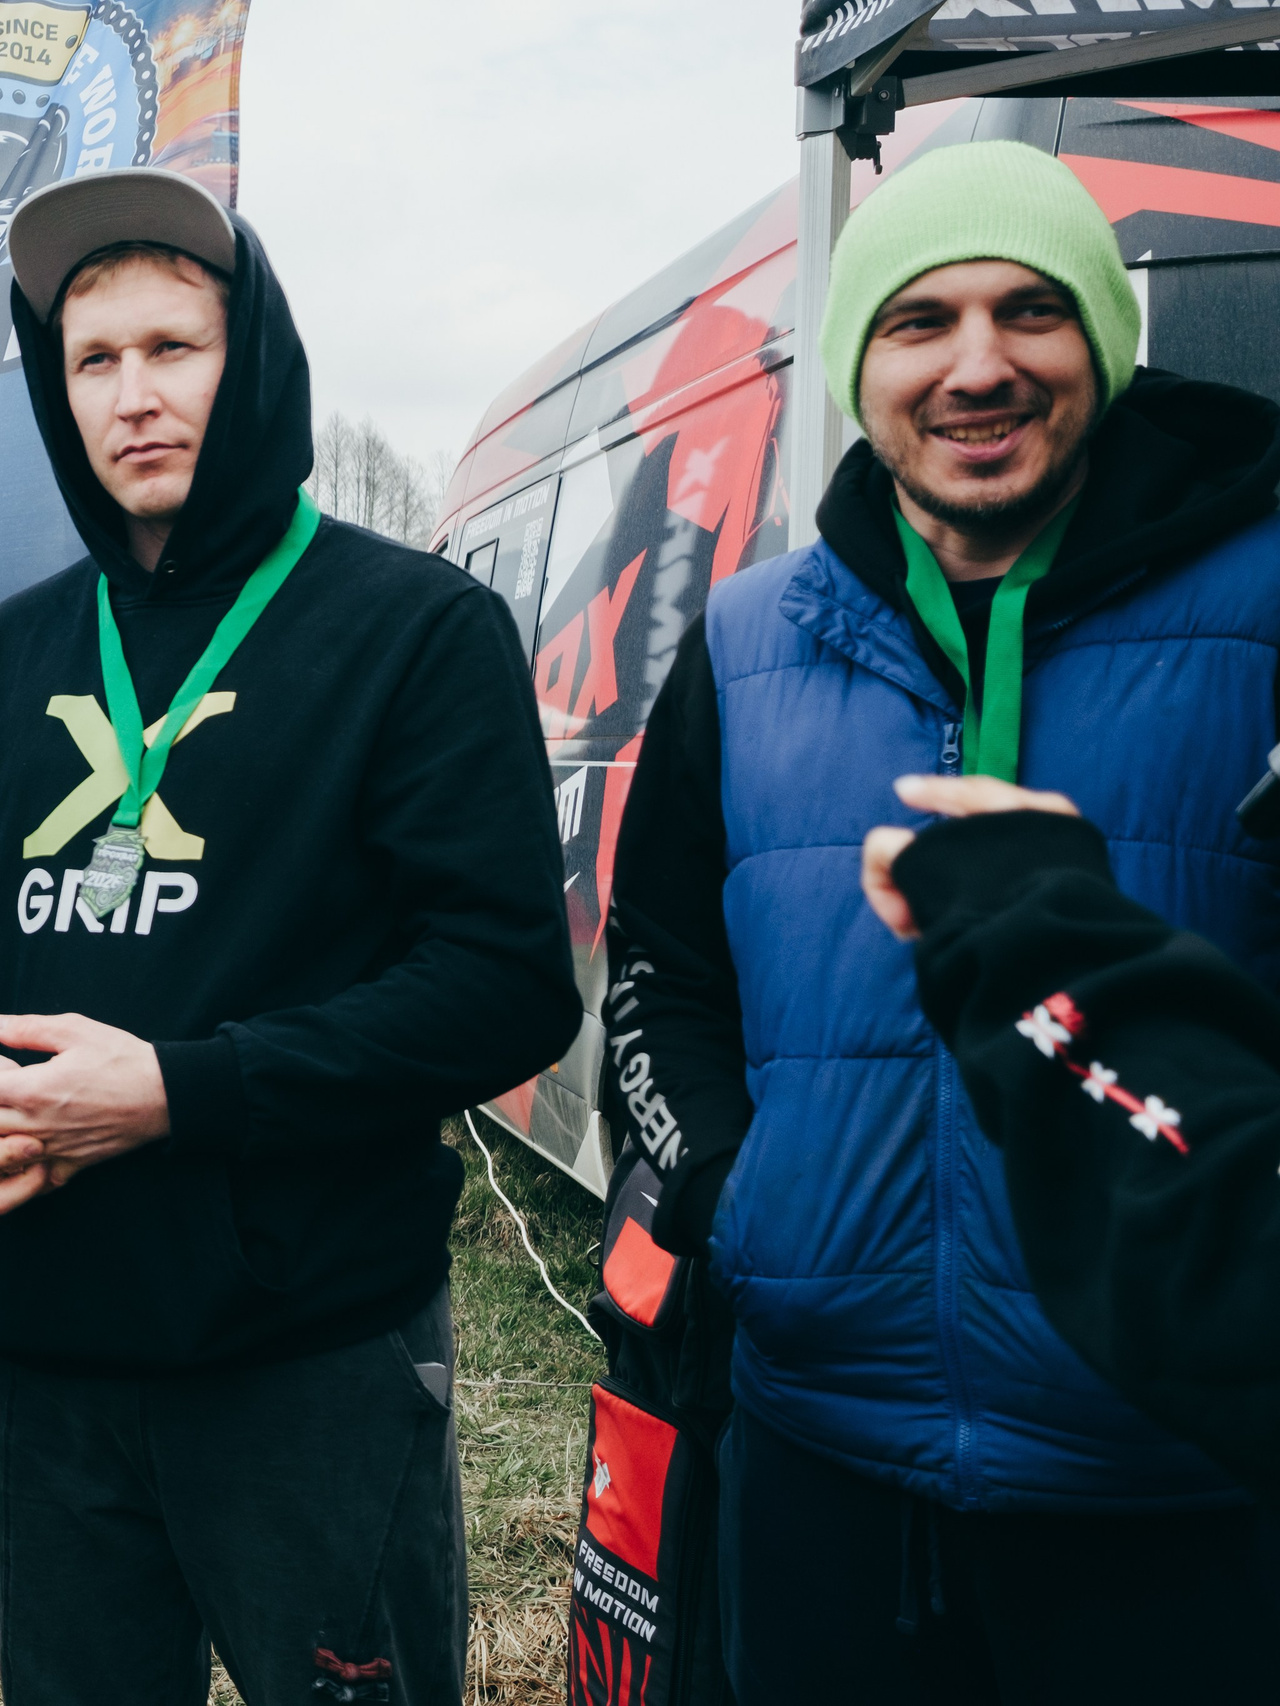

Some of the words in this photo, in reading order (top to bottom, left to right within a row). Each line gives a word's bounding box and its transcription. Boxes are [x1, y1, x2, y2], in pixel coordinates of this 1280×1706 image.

[465, 506, 504, 542] FREEDOM
[502, 502, 514, 524] IN
[513, 483, 551, 519] MOTION
[579, 1539, 660, 1614] FREEDOM
[583, 1580, 657, 1643] MOTION
